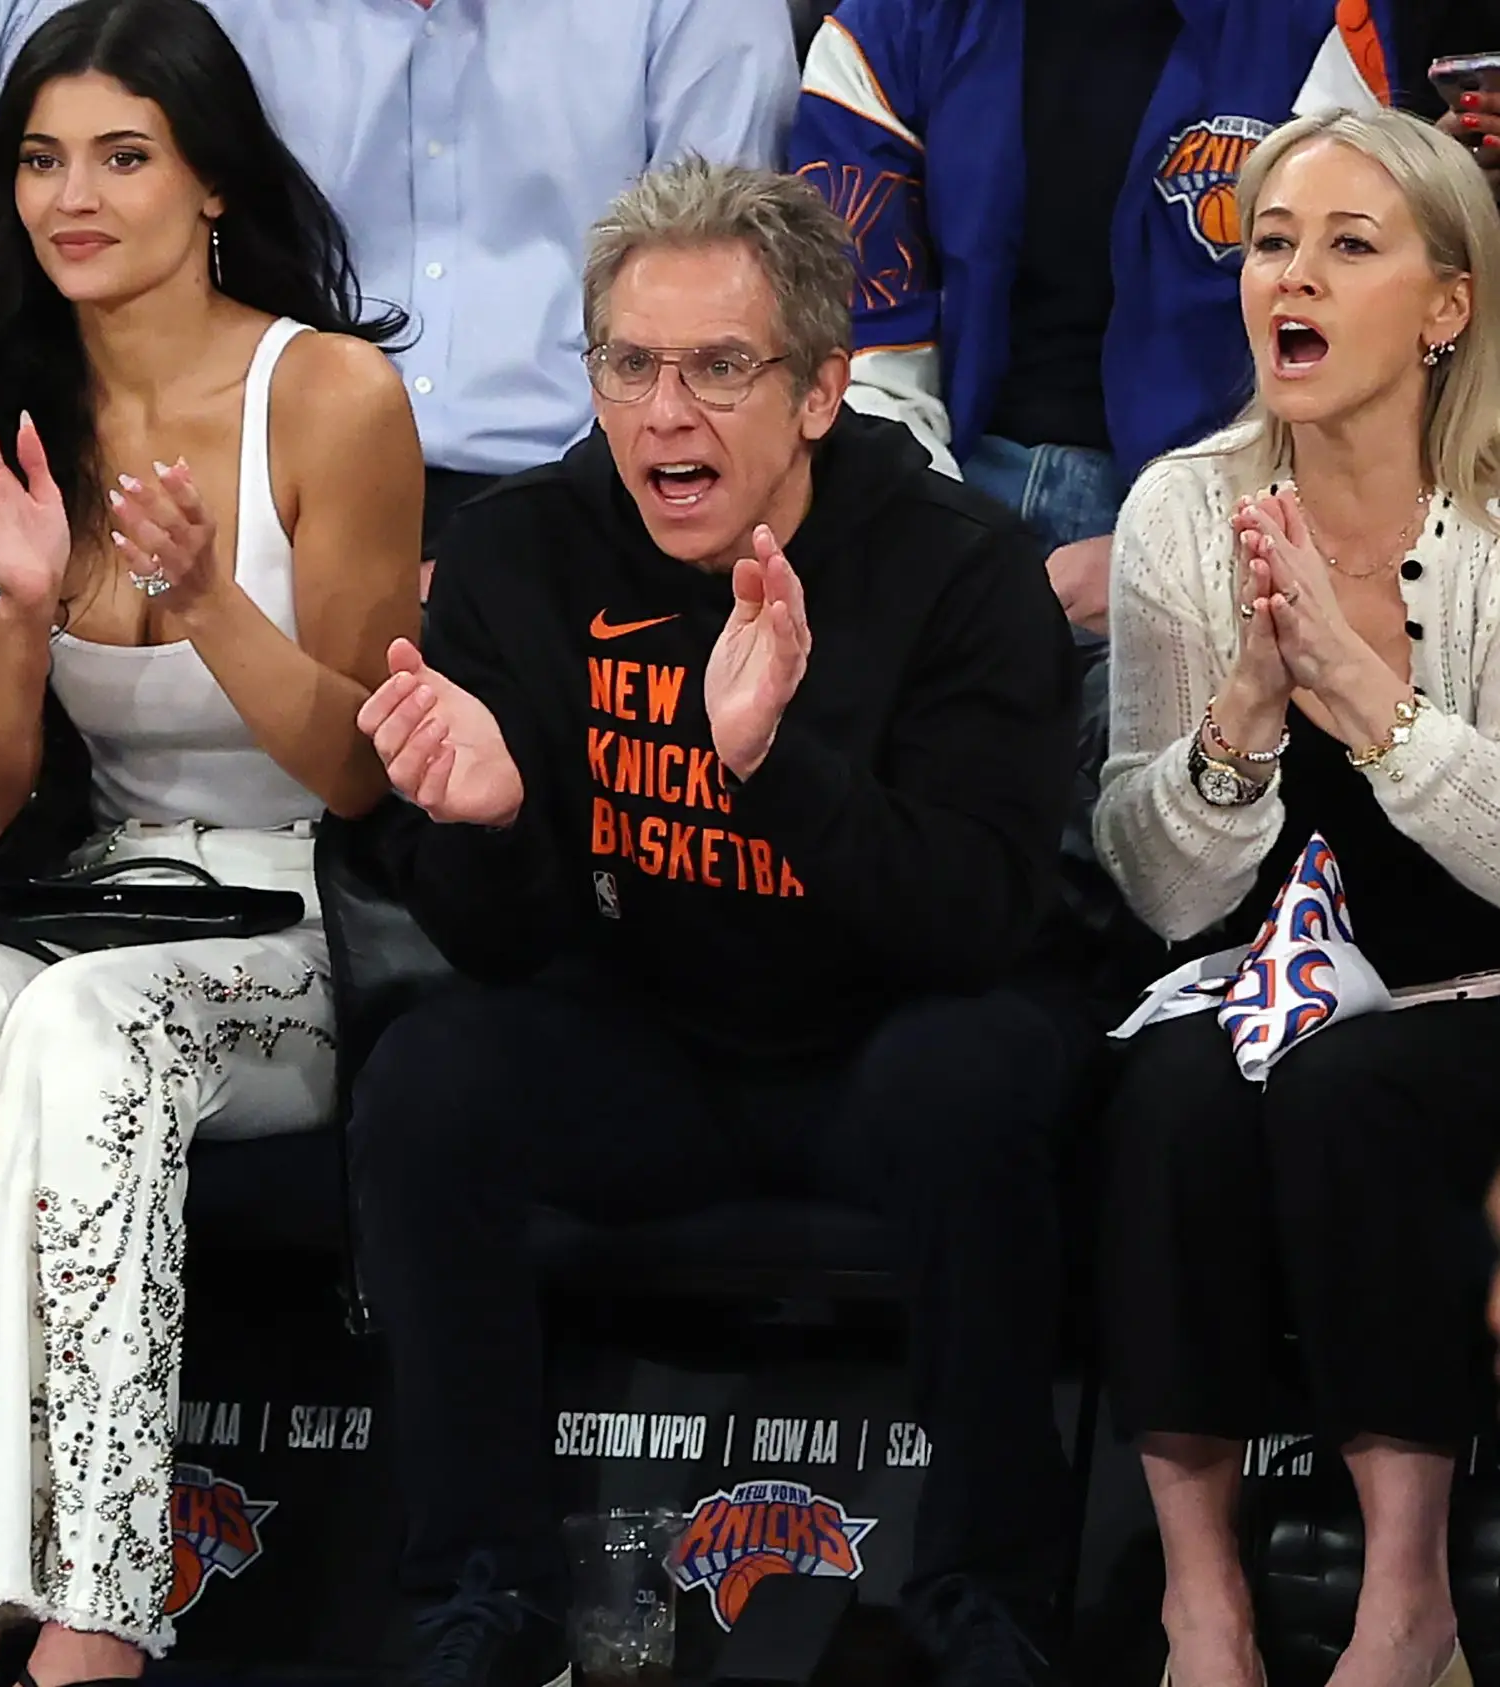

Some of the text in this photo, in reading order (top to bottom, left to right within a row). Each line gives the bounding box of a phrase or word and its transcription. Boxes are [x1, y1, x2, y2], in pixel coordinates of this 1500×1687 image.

[1164, 130, 1257, 178] KNI
[588, 656, 686, 726] NEW
[211, 1402, 241, 1446] AA
[288, 1405, 343, 1449] SEAT
[341, 1407, 372, 1450] 29
[554, 1411, 646, 1458] SECTION
[752, 1418, 808, 1463] ROW
[807, 1419, 839, 1464] AA
[886, 1422, 933, 1467] SEA
[732, 1484, 808, 1504] NEW YORK
[675, 1499, 855, 1573] KNICKS
